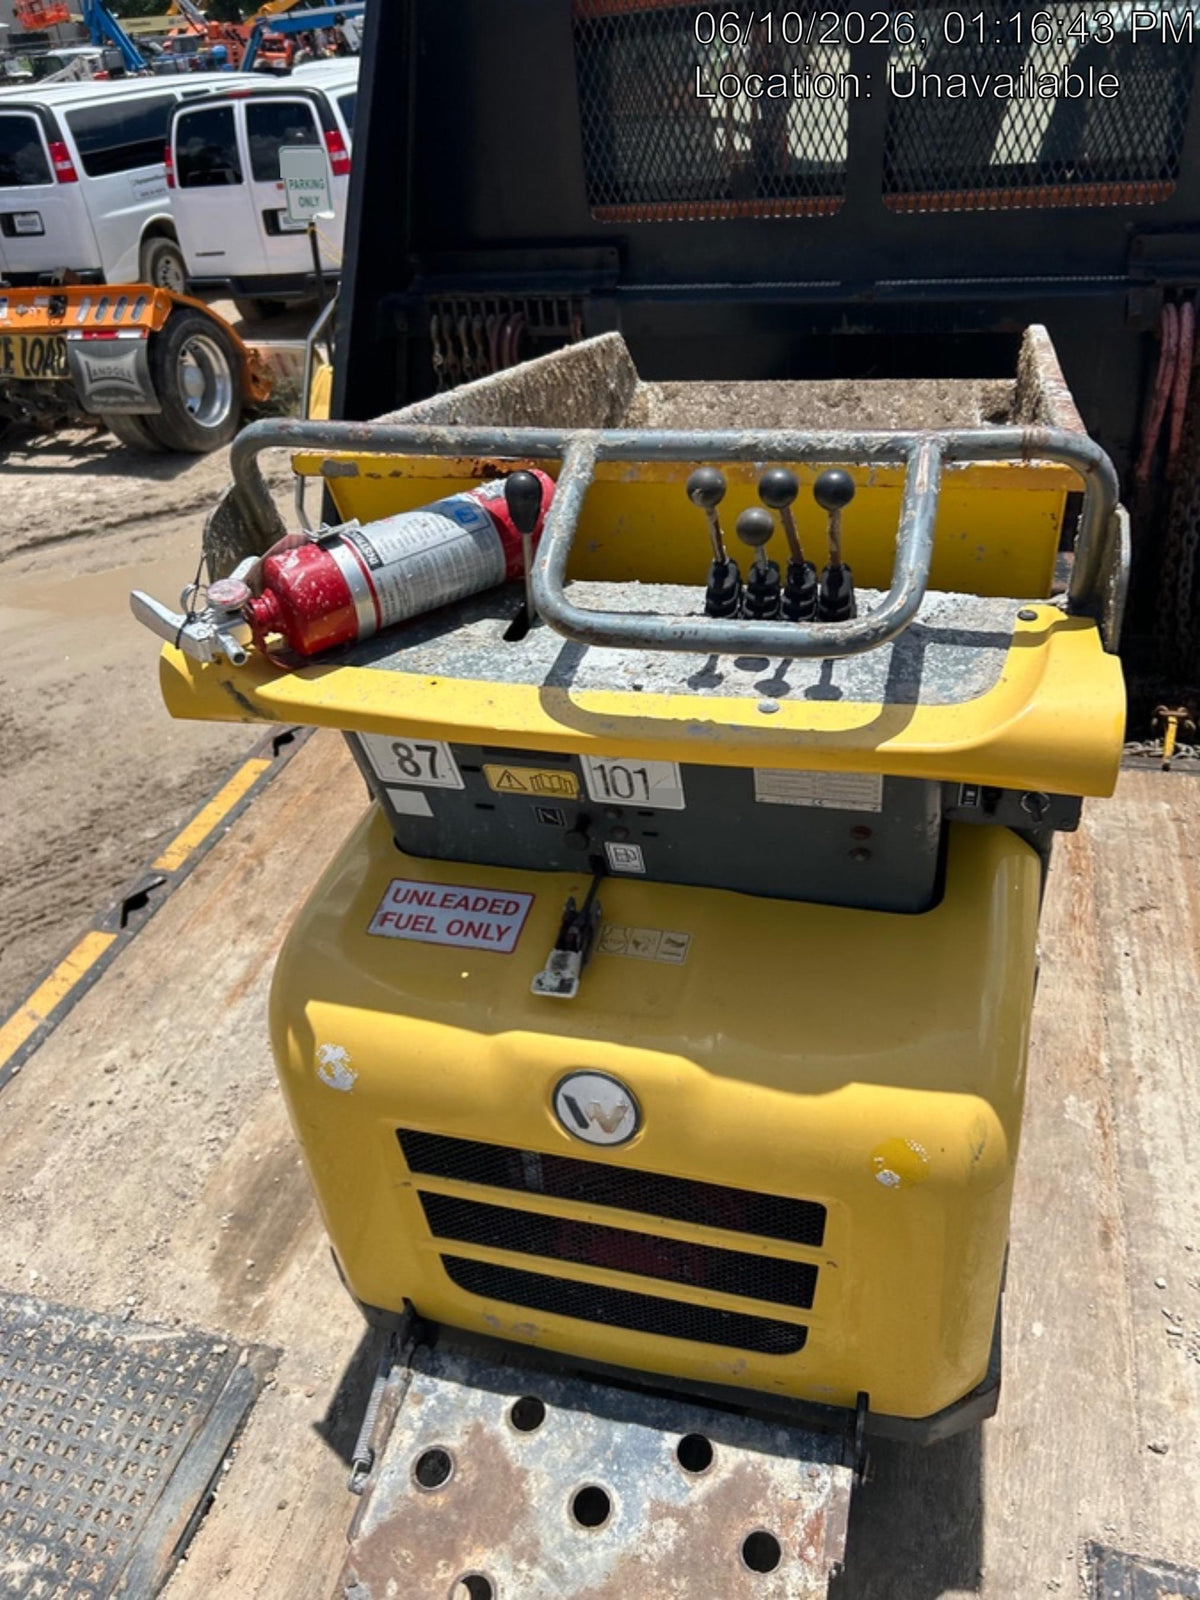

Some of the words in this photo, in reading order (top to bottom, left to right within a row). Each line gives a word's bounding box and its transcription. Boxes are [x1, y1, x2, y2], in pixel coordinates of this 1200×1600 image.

[288, 178, 326, 190] PARKING
[298, 195, 320, 208] ONLY
[20, 335, 70, 377] LOAD
[392, 742, 438, 779] 87
[593, 764, 650, 801] 101
[391, 887, 521, 917] UNLEADED
[379, 911, 438, 935] FUEL
[445, 918, 513, 943] ONLY
